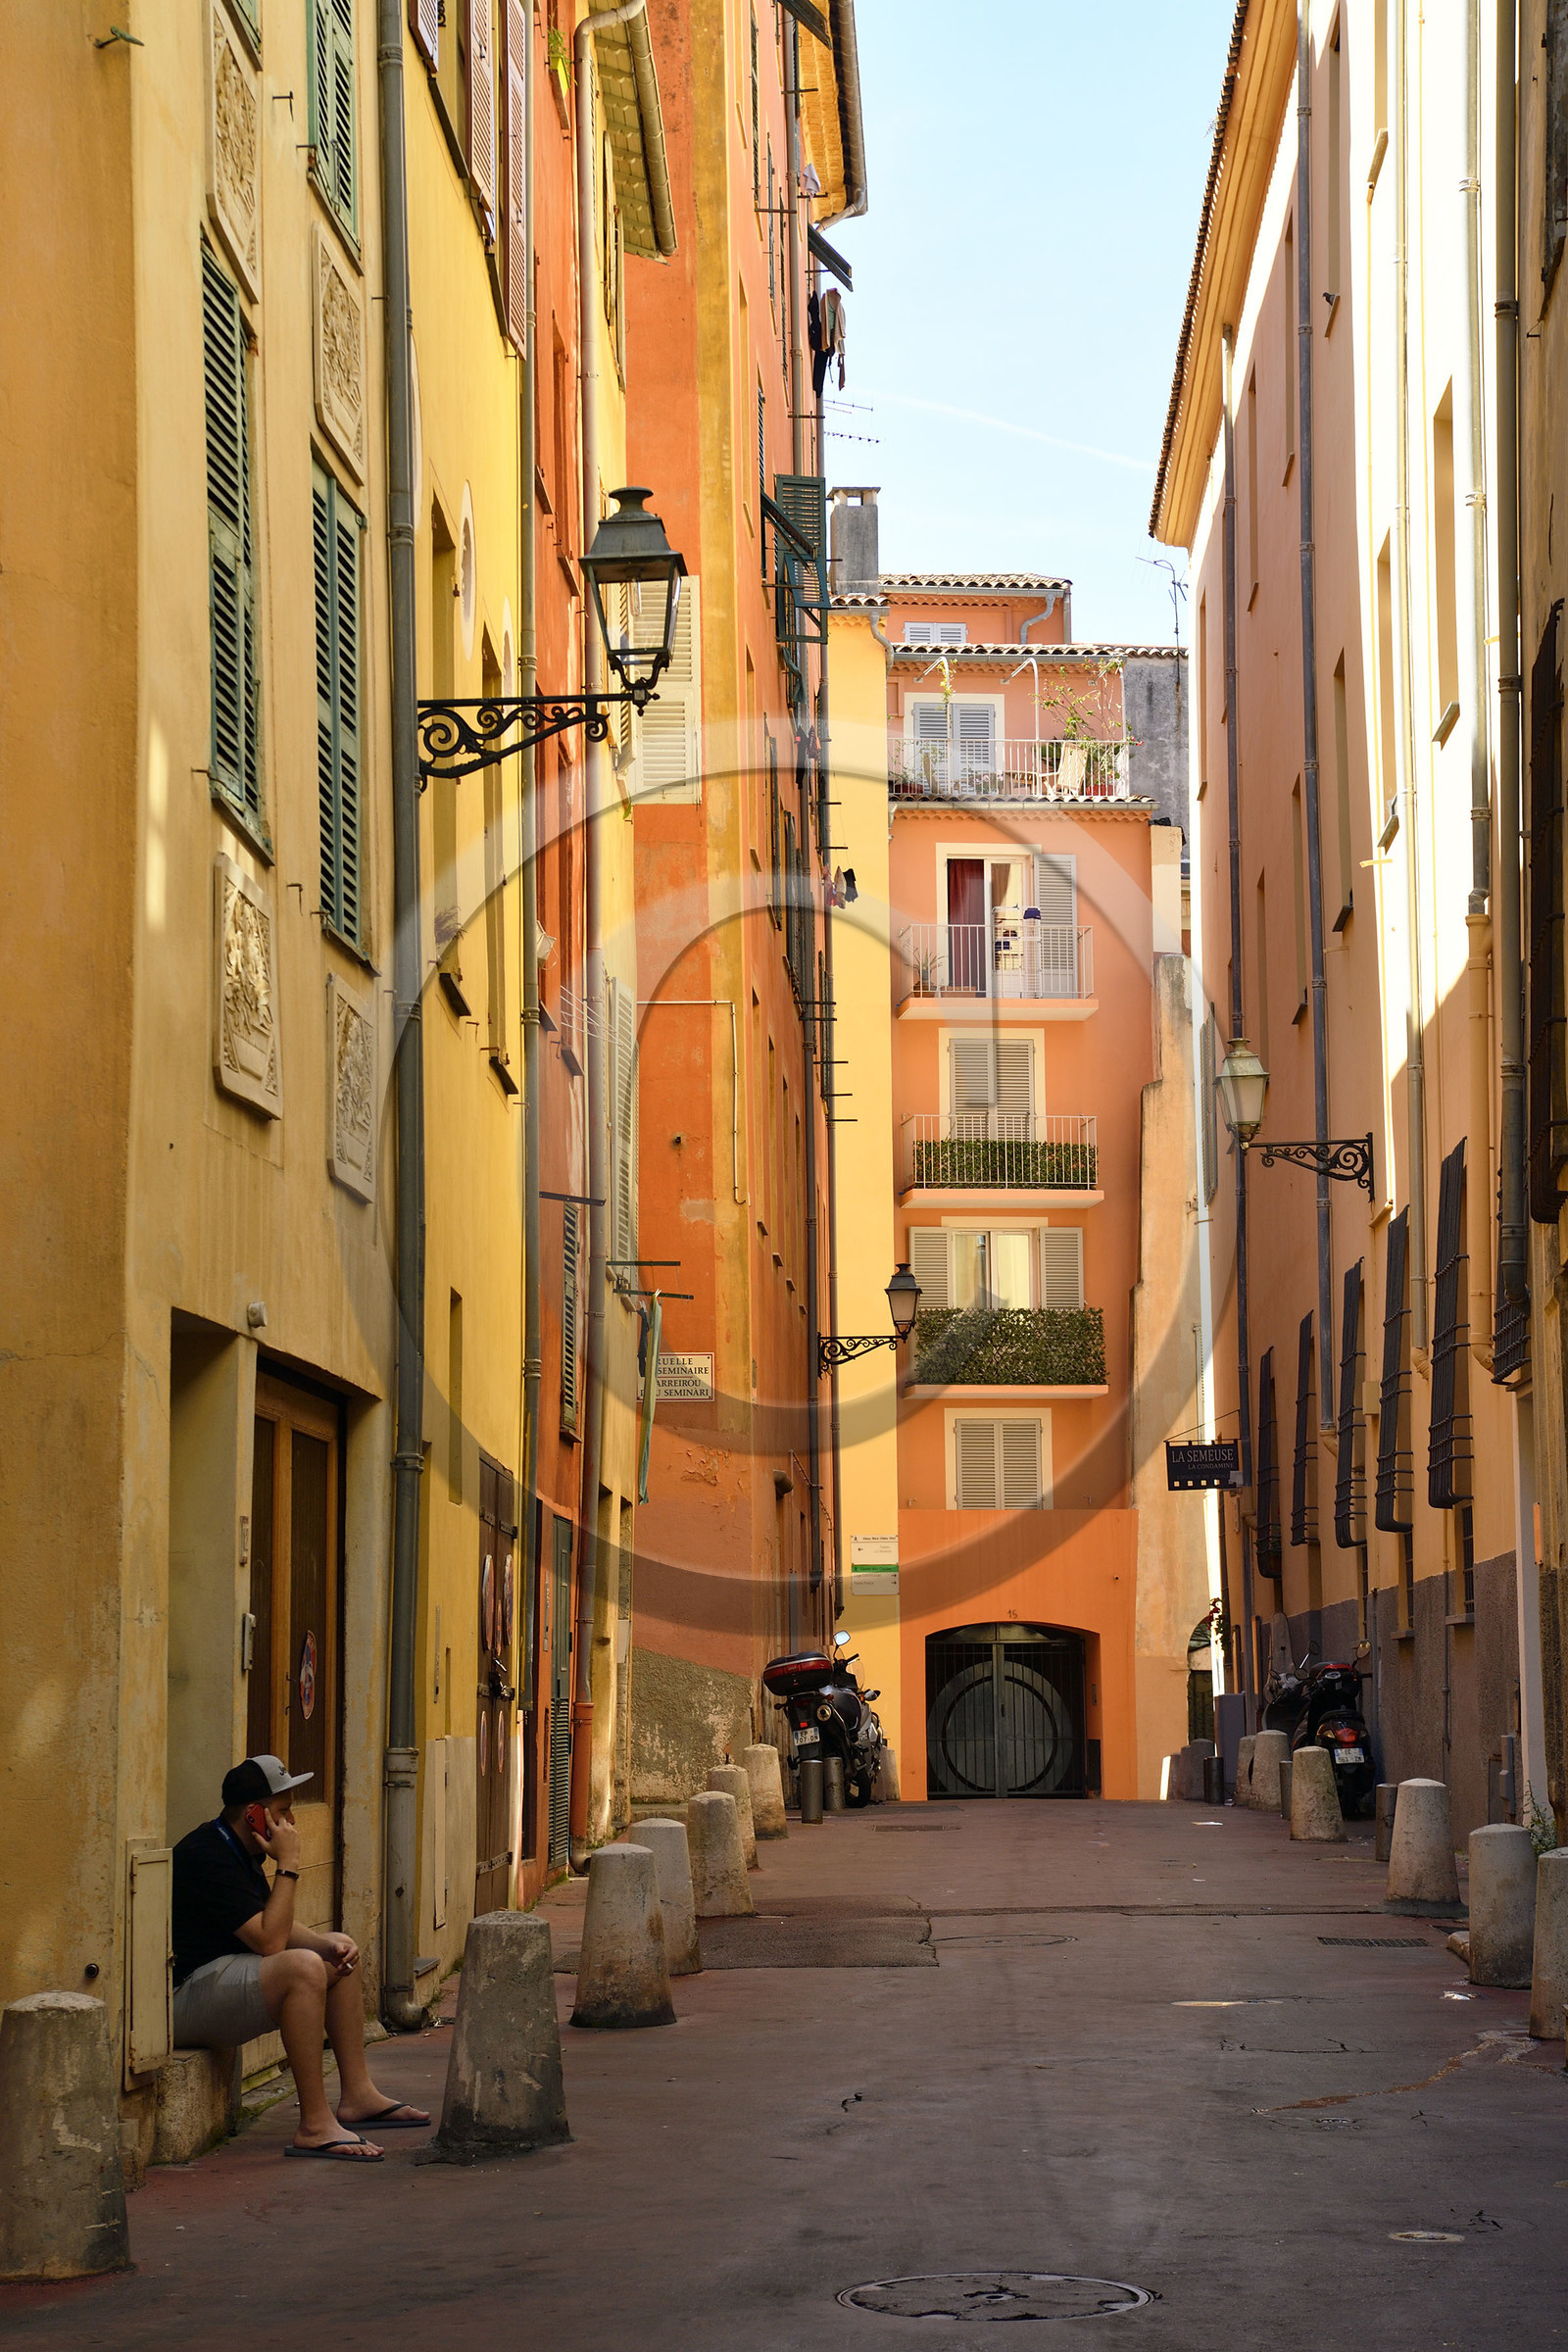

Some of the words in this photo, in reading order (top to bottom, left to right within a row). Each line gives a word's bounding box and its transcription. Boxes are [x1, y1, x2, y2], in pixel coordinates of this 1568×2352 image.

[658, 1366, 709, 1375] SEMINAIRE
[656, 1377, 701, 1388] ARREIRÒU
[1171, 1450, 1185, 1463] LA
[1187, 1448, 1234, 1462] SEMEUSE
[1007, 1609, 1018, 1619] 15
